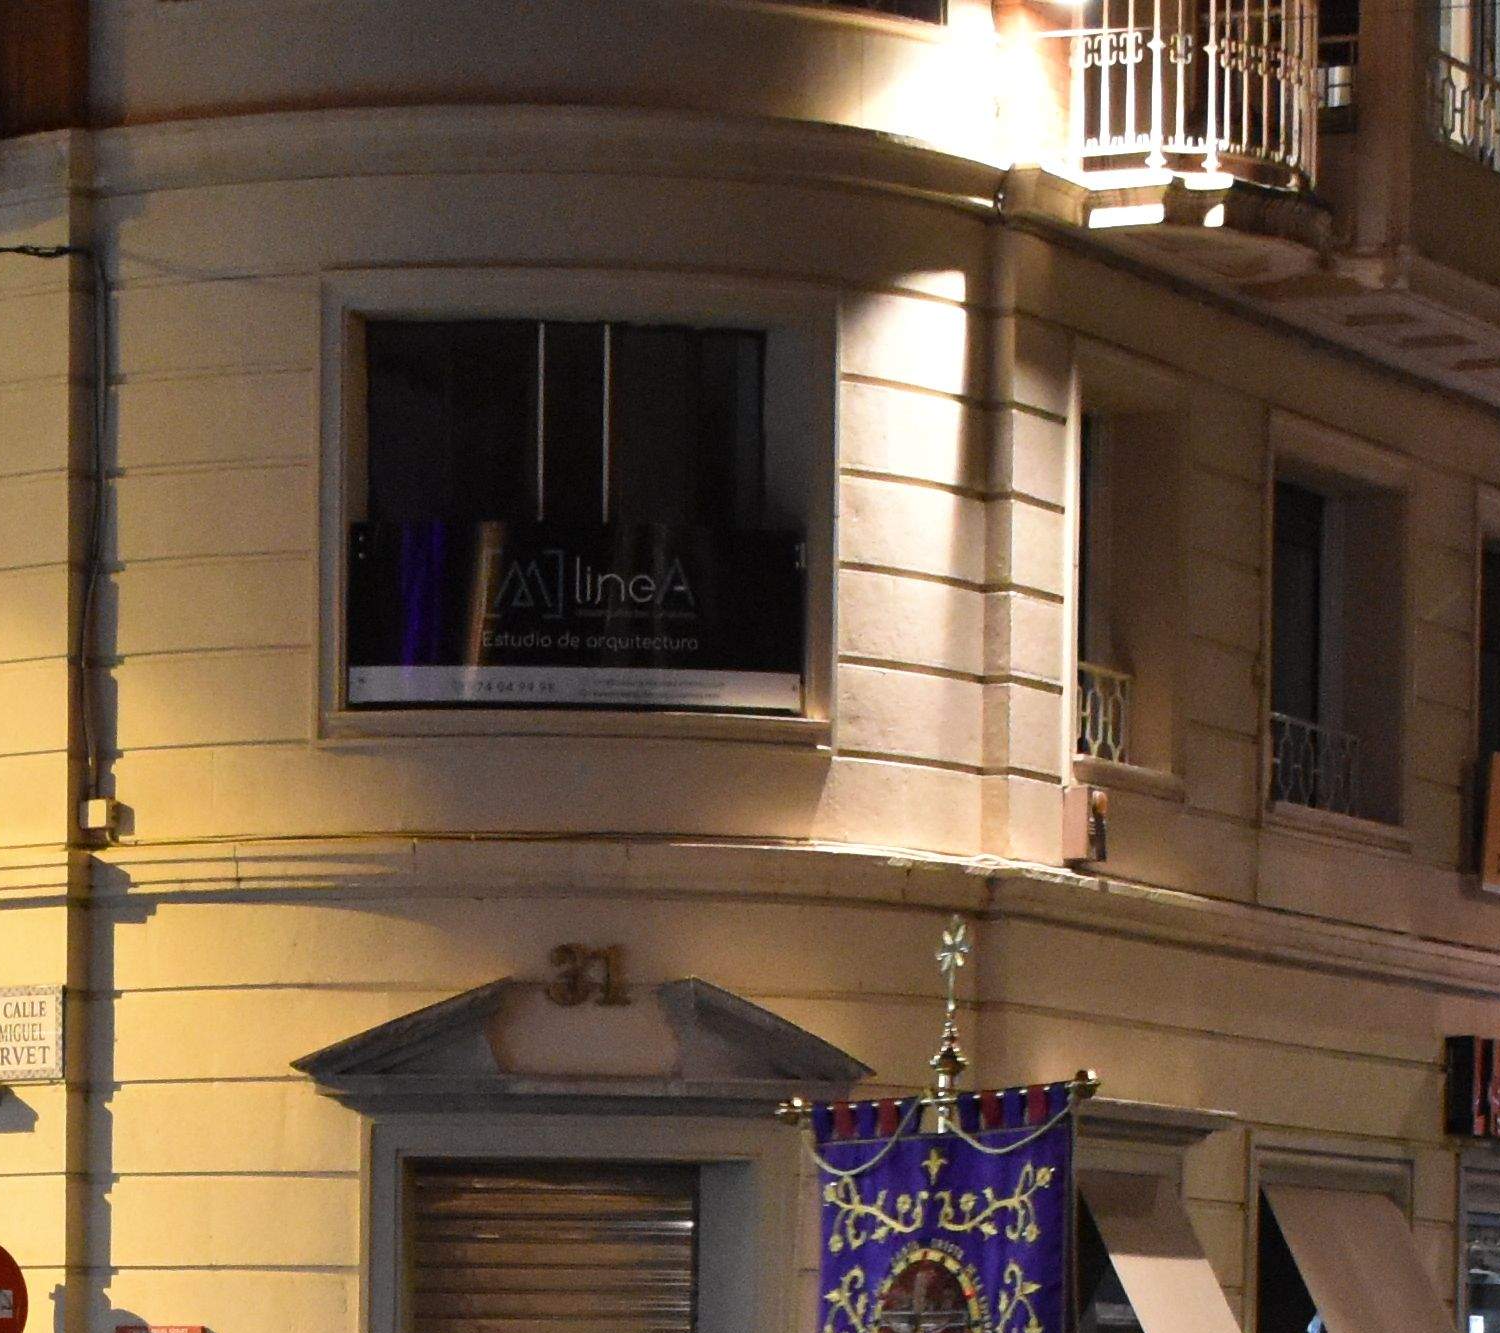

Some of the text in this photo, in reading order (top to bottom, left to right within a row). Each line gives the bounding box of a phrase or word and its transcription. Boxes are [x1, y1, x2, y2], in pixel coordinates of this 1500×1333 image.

[482, 630, 699, 652] Estudio de arquitectura
[545, 942, 633, 1008] 31
[2, 1000, 48, 1019] CALLE
